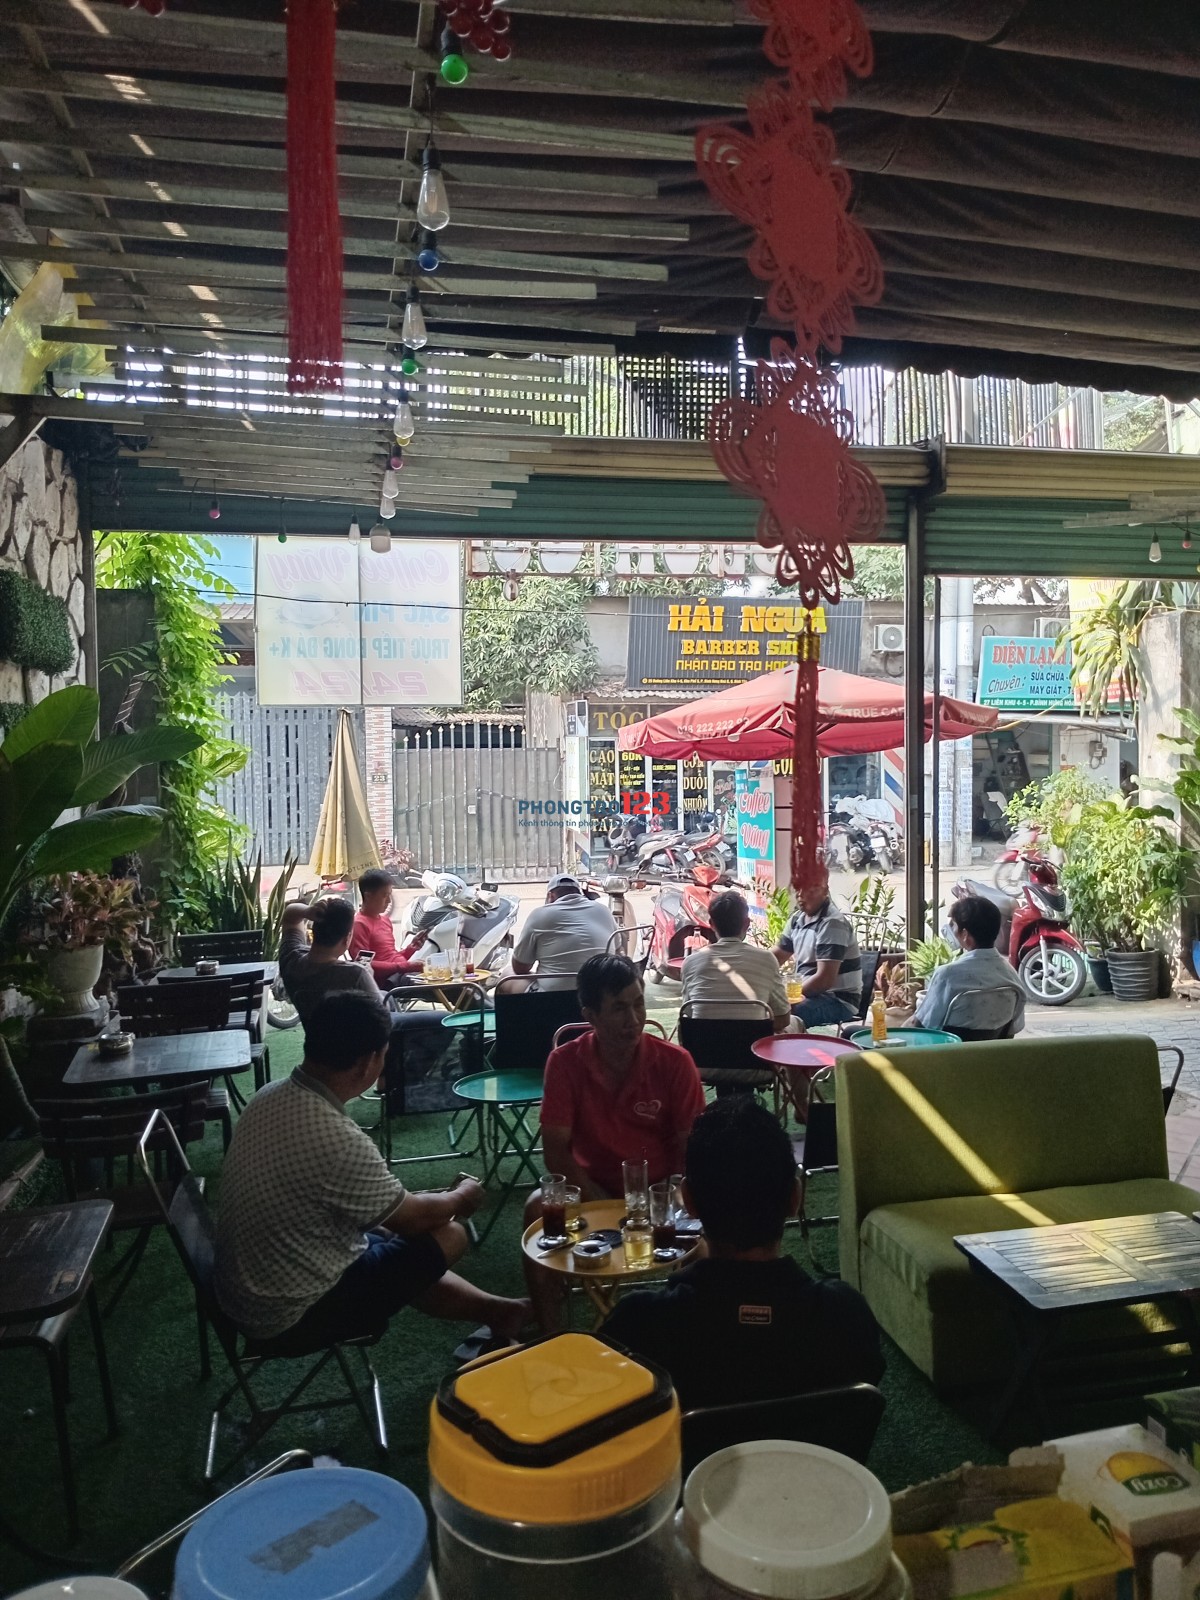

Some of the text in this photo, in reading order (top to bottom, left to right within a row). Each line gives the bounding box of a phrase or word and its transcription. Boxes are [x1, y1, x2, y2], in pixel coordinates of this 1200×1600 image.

[668, 598, 724, 632] HẢI
[681, 640, 760, 655] BARBER
[992, 639, 1027, 669] ĐIỆN
[676, 658, 709, 672] NHẬN
[711, 658, 736, 671] ĐÀO
[739, 660, 762, 673] TẠO
[590, 767, 615, 788] MẶT
[740, 787, 771, 818] Coffee
[1130, 1476, 1183, 1492] Cozy
